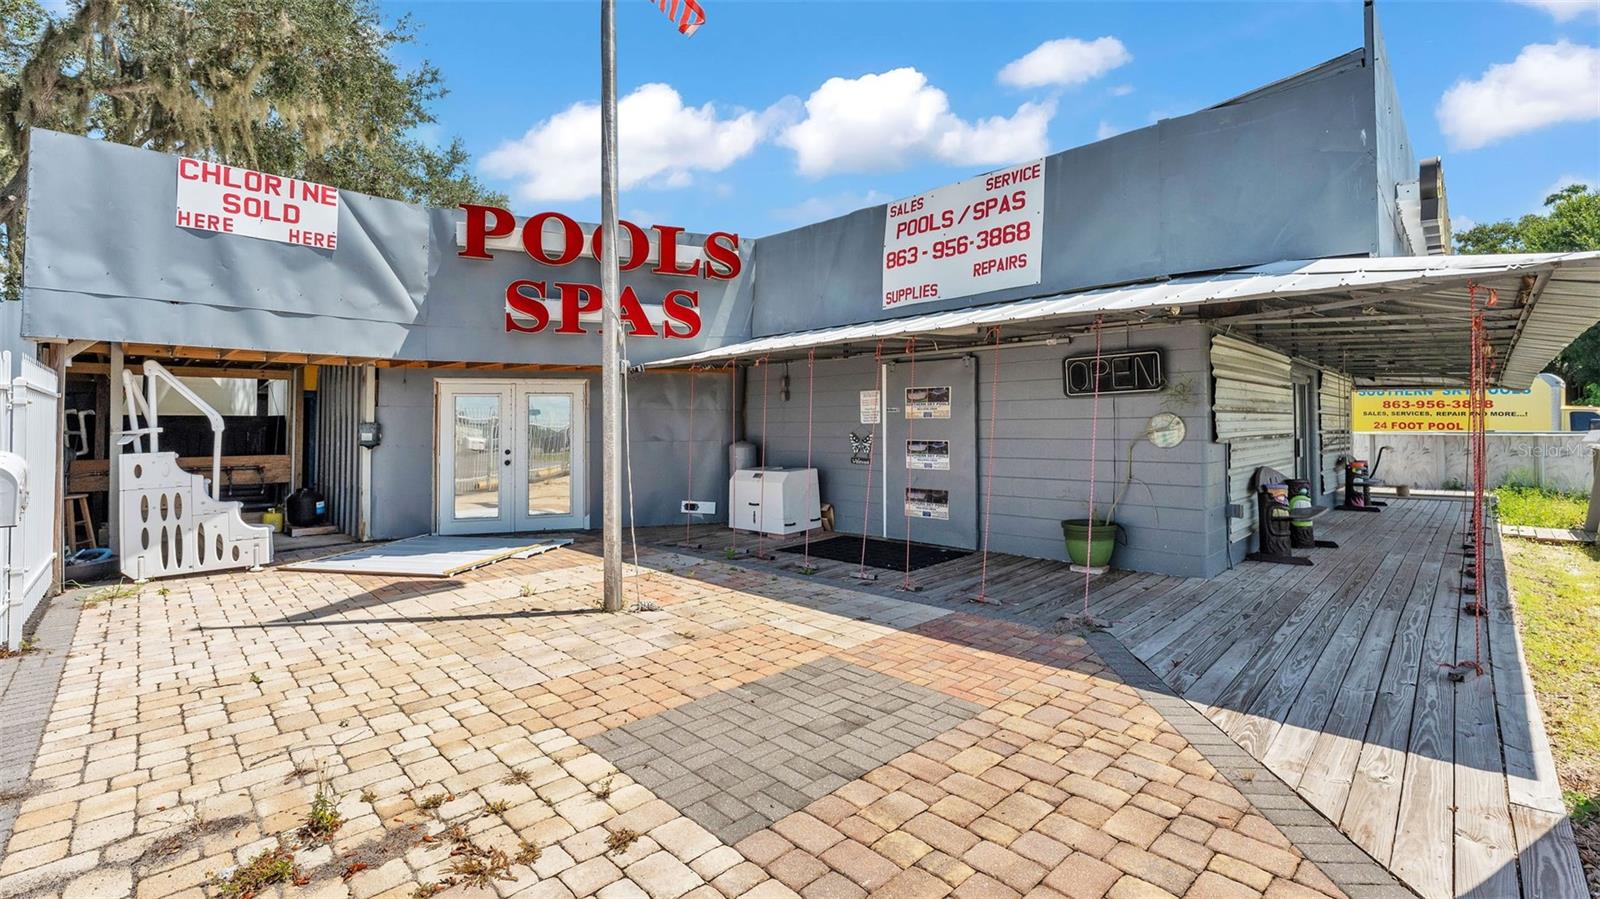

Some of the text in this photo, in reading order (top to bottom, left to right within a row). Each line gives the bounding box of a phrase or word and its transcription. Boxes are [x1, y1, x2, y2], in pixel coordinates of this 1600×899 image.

[179, 158, 337, 207] CHLORINE
[985, 163, 1041, 191] SERVICE
[177, 210, 234, 232] HERE
[222, 193, 301, 225] SOLD
[889, 197, 925, 218] SALES
[288, 228, 337, 249] HERE
[456, 202, 742, 280] POOLS
[886, 221, 1031, 270] 863-956-3868
[972, 253, 1028, 278] REPAIRS
[885, 283, 939, 305] SUPPLIES
[504, 279, 702, 340] SPAS
[1069, 356, 1156, 391] OPEN
[1373, 421, 1388, 430] 24
[1391, 421, 1425, 430] FOOT
